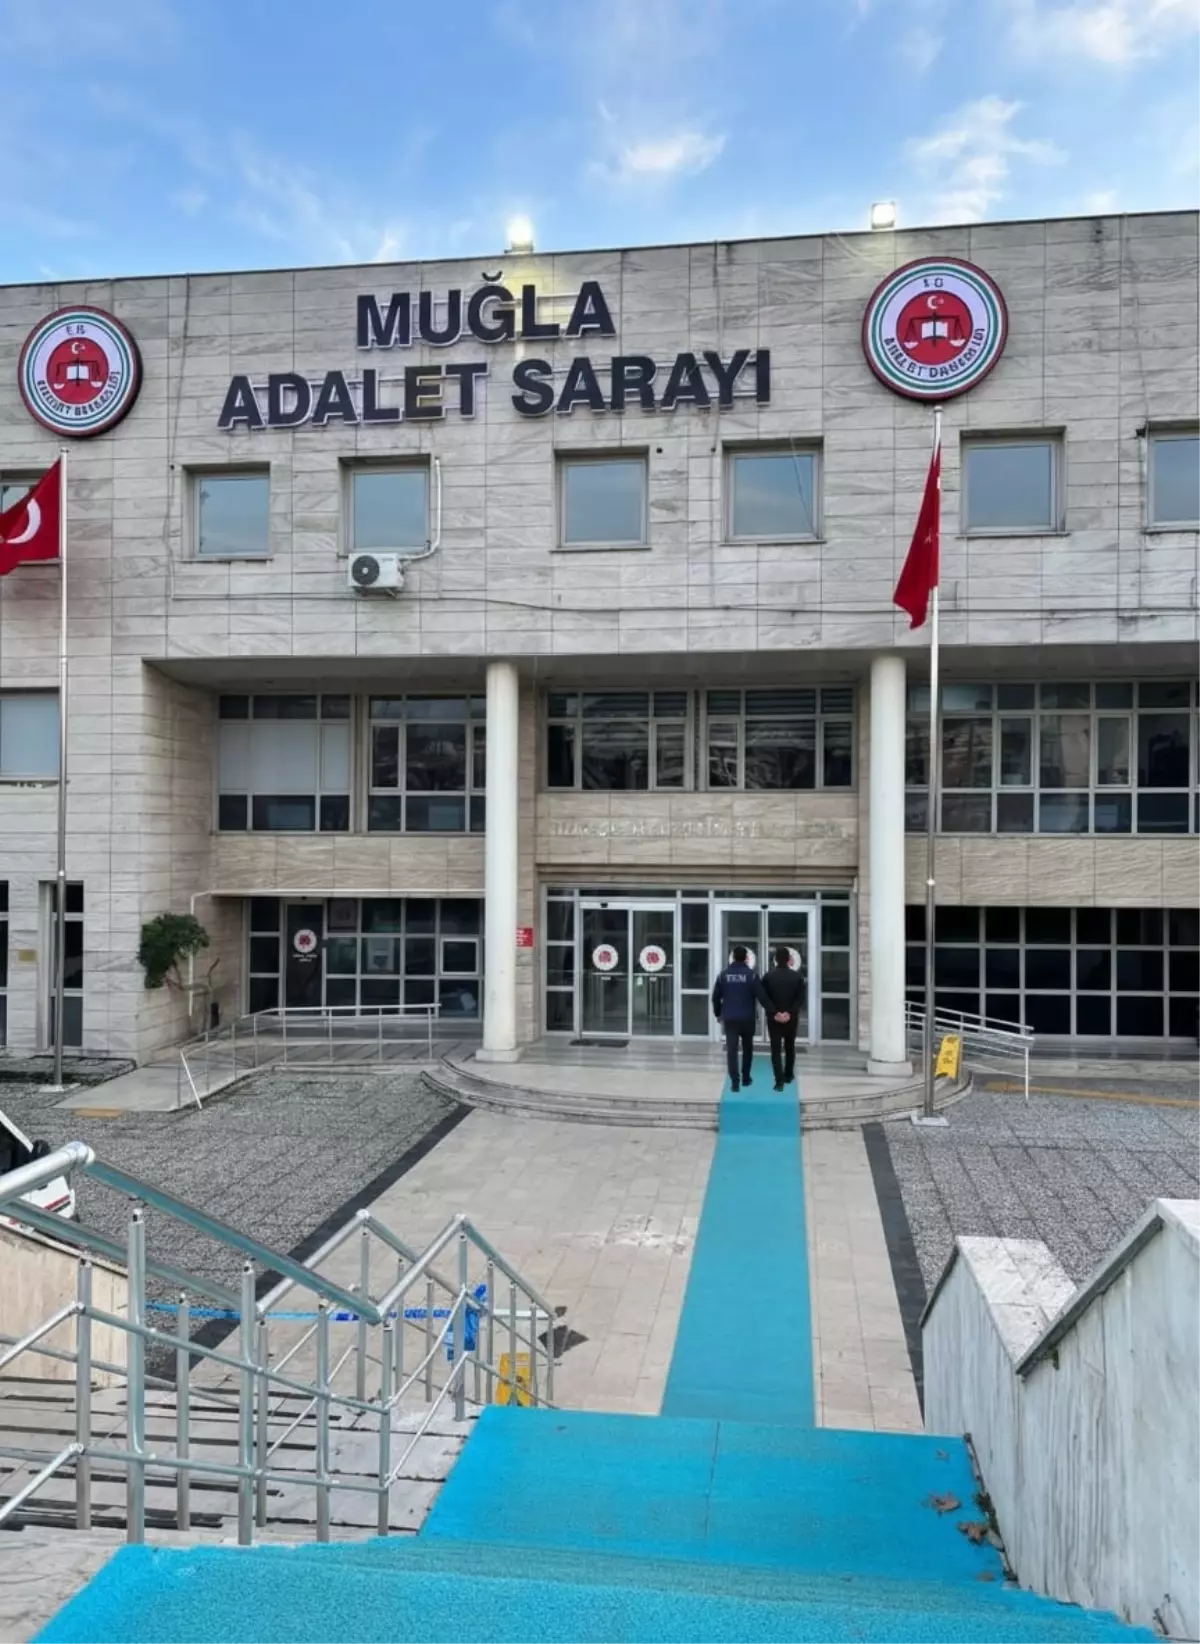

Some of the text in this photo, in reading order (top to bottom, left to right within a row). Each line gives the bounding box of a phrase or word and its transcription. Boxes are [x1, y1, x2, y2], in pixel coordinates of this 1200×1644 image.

[357, 271, 616, 348] MUĞLA
[218, 349, 770, 429] ADALET SARAYI
